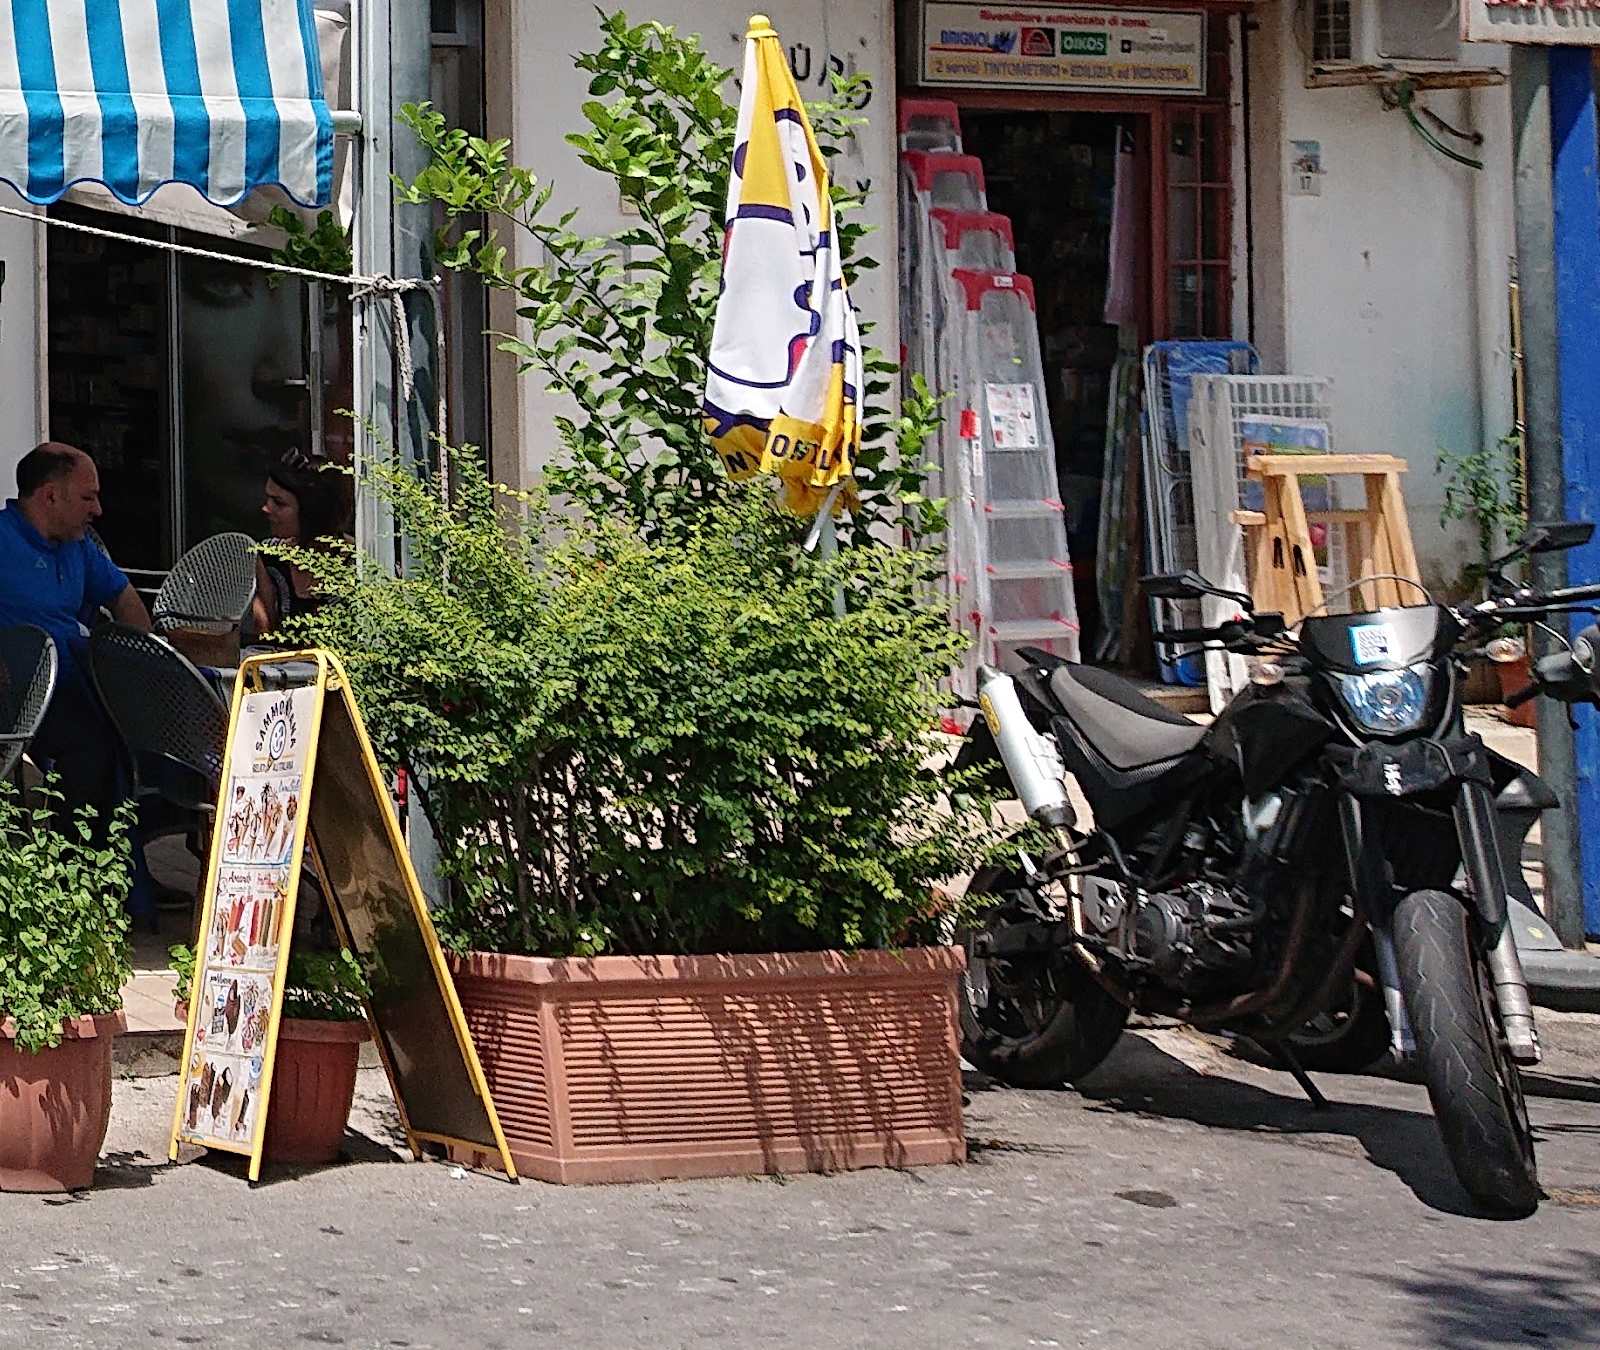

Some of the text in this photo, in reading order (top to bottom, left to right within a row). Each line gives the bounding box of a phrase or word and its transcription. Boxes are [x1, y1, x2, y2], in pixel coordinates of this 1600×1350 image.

[1108, 14, 1119, 27] di
[1063, 35, 1105, 51] OIKOS
[935, 63, 943, 74] 2
[255, 699, 297, 752] SAMMONTANA
